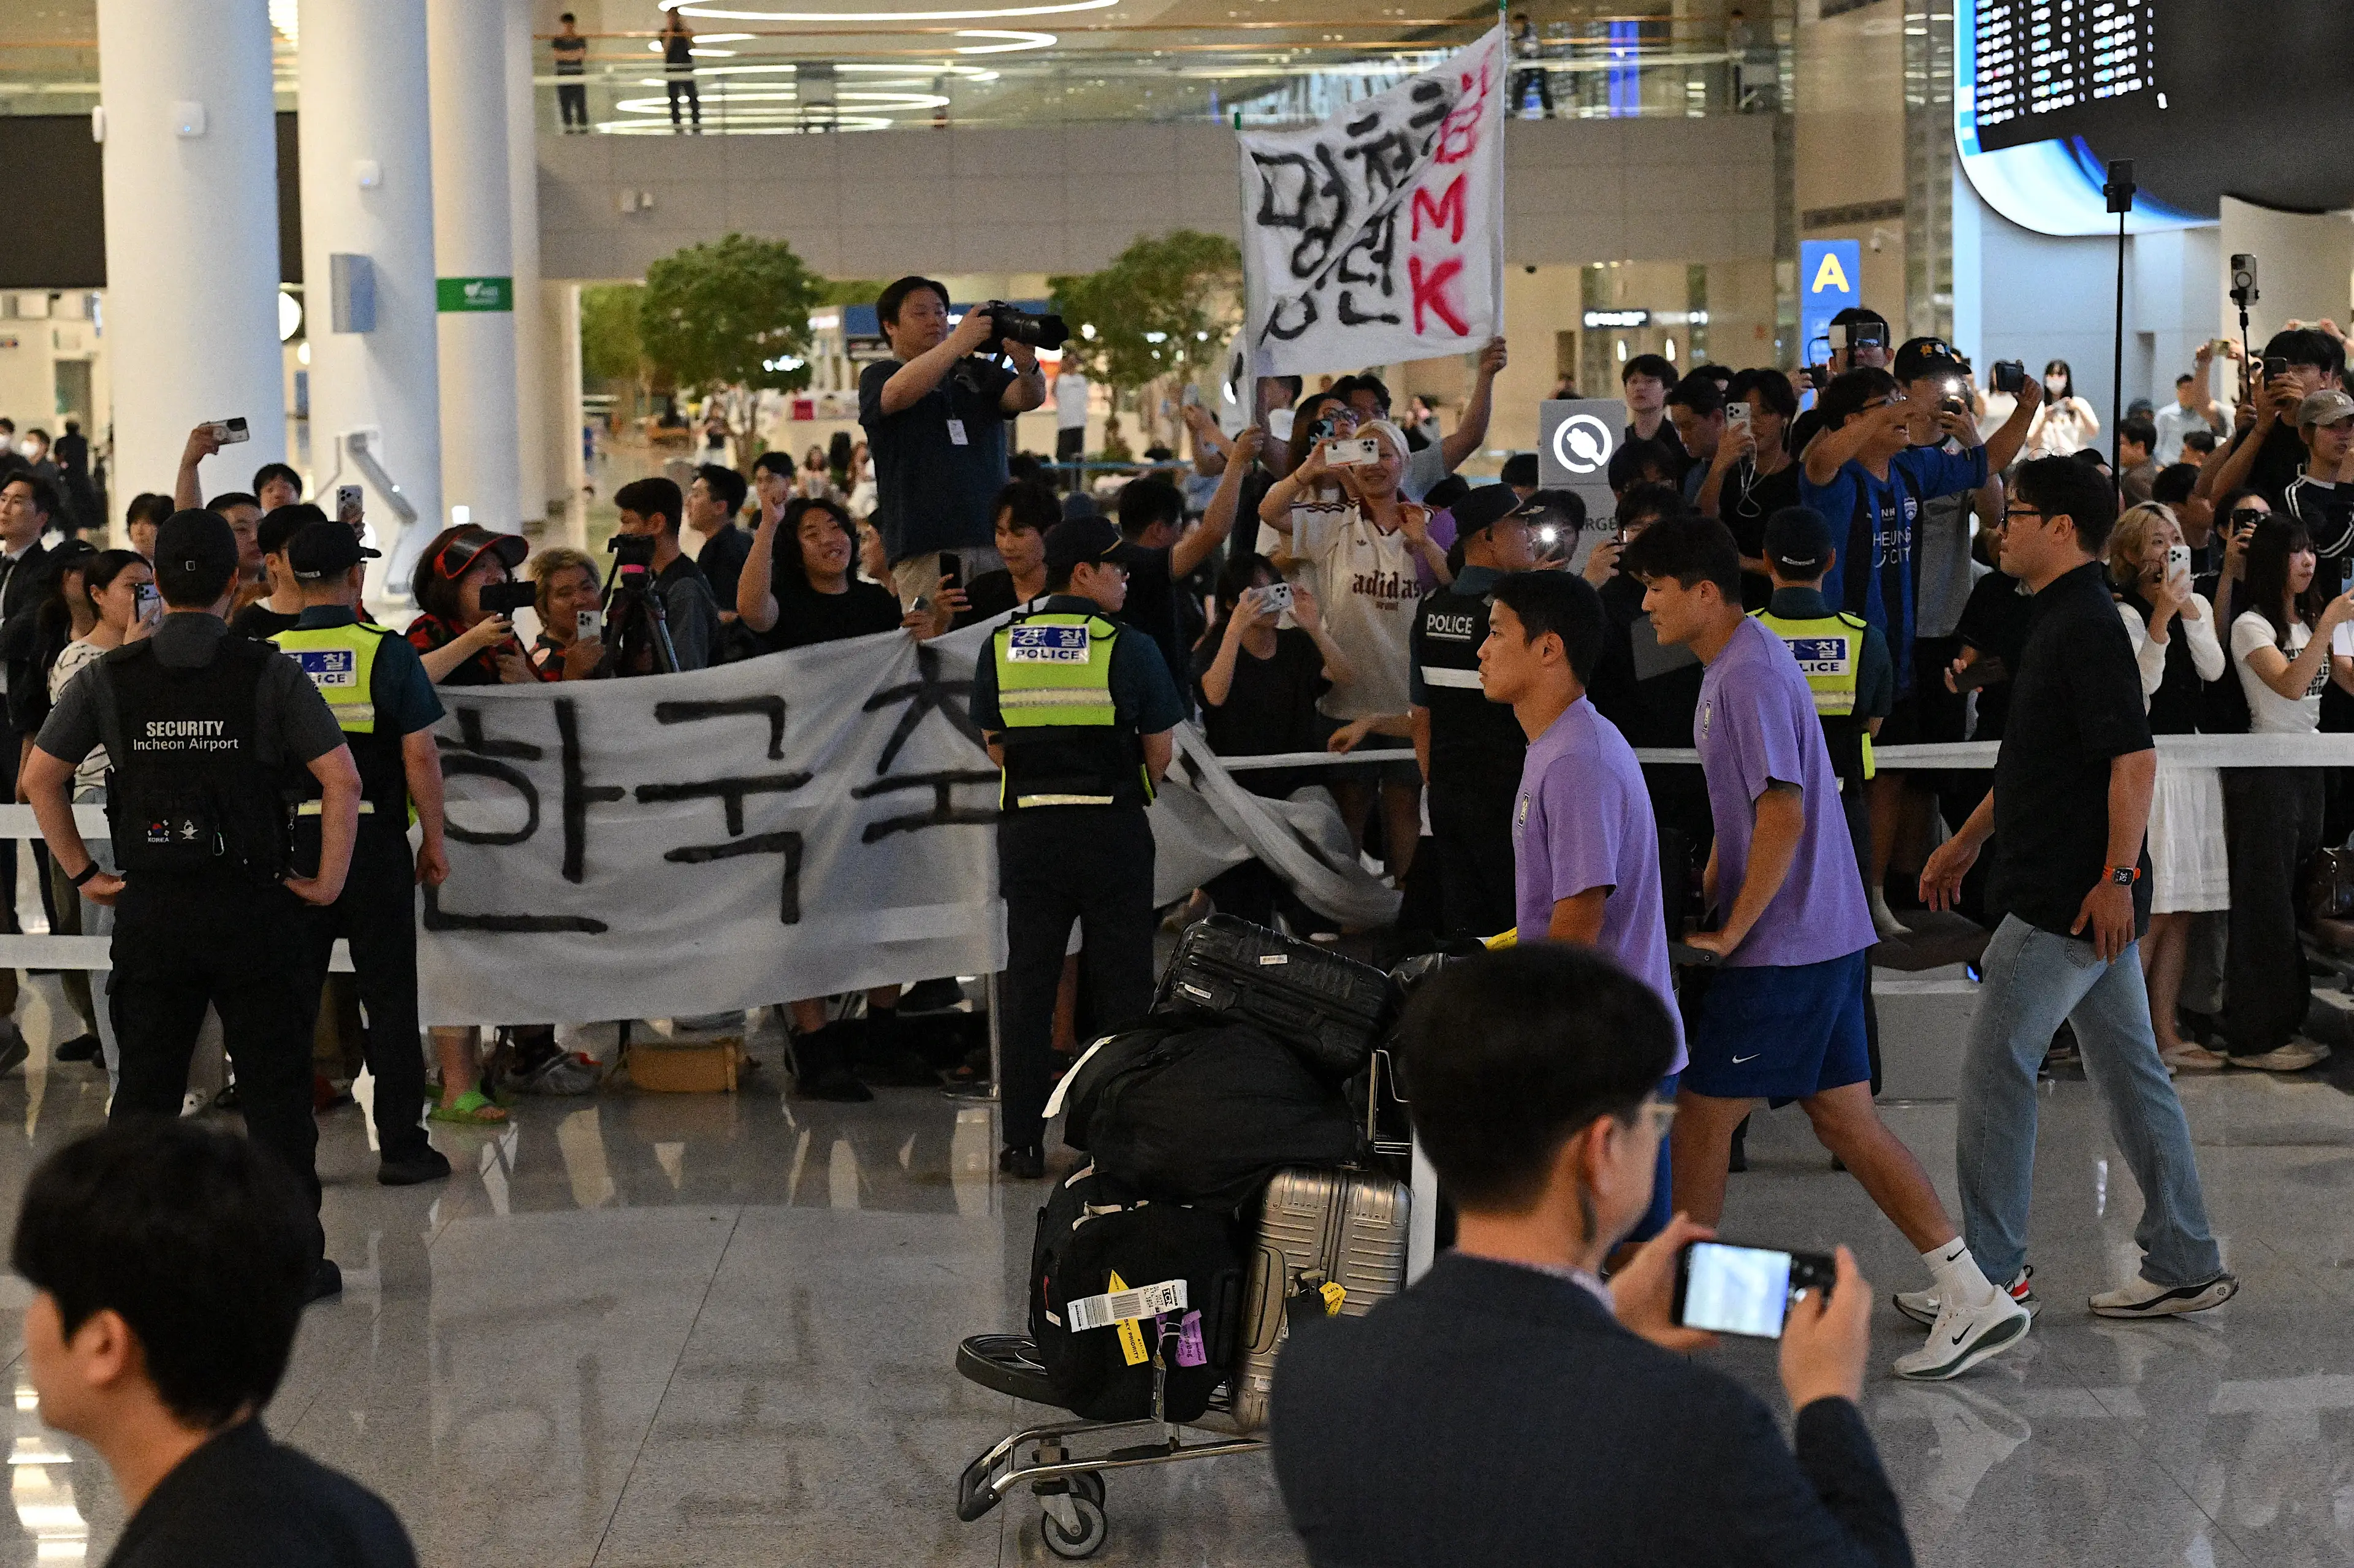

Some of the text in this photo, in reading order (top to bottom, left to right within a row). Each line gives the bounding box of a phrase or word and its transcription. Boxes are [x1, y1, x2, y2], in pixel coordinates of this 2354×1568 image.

[1812, 253, 1850, 293] A
[1585, 517, 1617, 531] RGE
[1353, 569, 1422, 599] adidas
[1426, 613, 1473, 634] POLICE
[1013, 628, 1083, 647] 경찰
[1015, 649, 1080, 660] POLICE
[1800, 662, 1839, 672] LICE
[317, 674, 346, 683] ICE
[146, 720, 224, 737] SECURITY
[133, 737, 239, 752] Incheon Airport
[423, 644, 1000, 933] 한국축
[1163, 1288, 1173, 1306] ICN
[1127, 1332, 1140, 1359] PRIORITY
